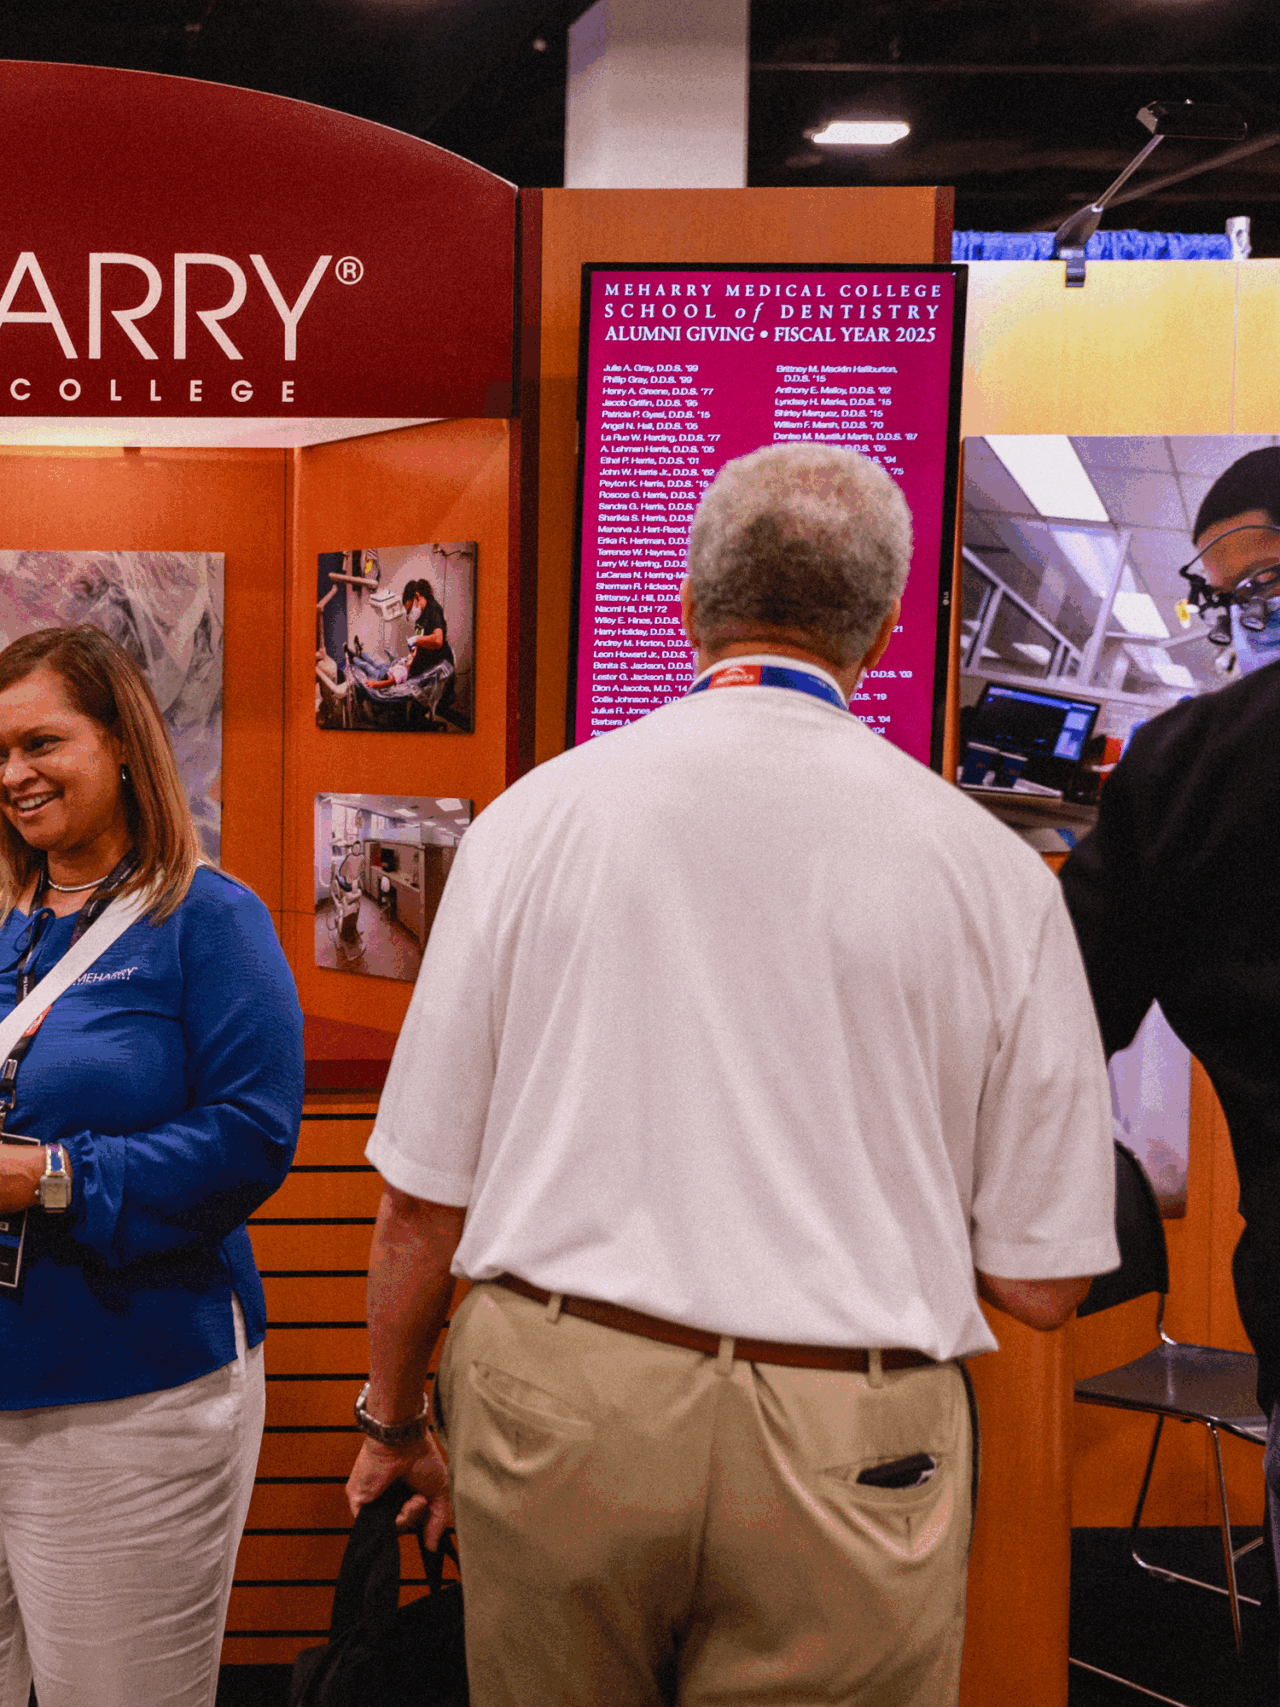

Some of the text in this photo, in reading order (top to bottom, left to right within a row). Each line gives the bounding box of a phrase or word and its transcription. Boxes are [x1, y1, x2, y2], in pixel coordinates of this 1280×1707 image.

[605, 284, 940, 297] MEHARRY MEDICAL COLLEGE
[605, 302, 938, 323] SCHOOL of DENTISTRY
[605, 326, 936, 342] ALUMNI GIVING FISCAL YEAR 2025
[634, 364, 655, 373] Gray,
[657, 364, 683, 372] D.D.S.
[628, 376, 648, 384] Gray,
[11, 378, 295, 403] COLLEGE
[602, 387, 627, 396] Henry
[639, 387, 670, 396] Greene,
[775, 386, 809, 395] Anthony
[810, 386, 819, 394] E.
[656, 399, 682, 407] D.D.S.
[850, 398, 876, 406] D.D.S.
[602, 410, 631, 418] Patricia
[656, 422, 683, 430] D.D.S.
[841, 421, 867, 429] D.D.S.
[645, 445, 671, 453] Harris,
[673, 445, 699, 453] D.D.S.
[631, 457, 657, 465] Harris,
[673, 468, 699, 476] D.D.S.
[640, 480, 665, 488] Harris,
[599, 491, 630, 499] Roscoe
[670, 491, 697, 499] D.D.S.
[641, 503, 666, 511] Harris,
[642, 514, 667, 522] Harris,
[597, 560, 617, 568] Larry
[594, 628, 616, 636] Harry
[630, 662, 666, 670] Jackson,
[871, 670, 897, 678] D.D.S.
[591, 718, 623, 726] Barbara
